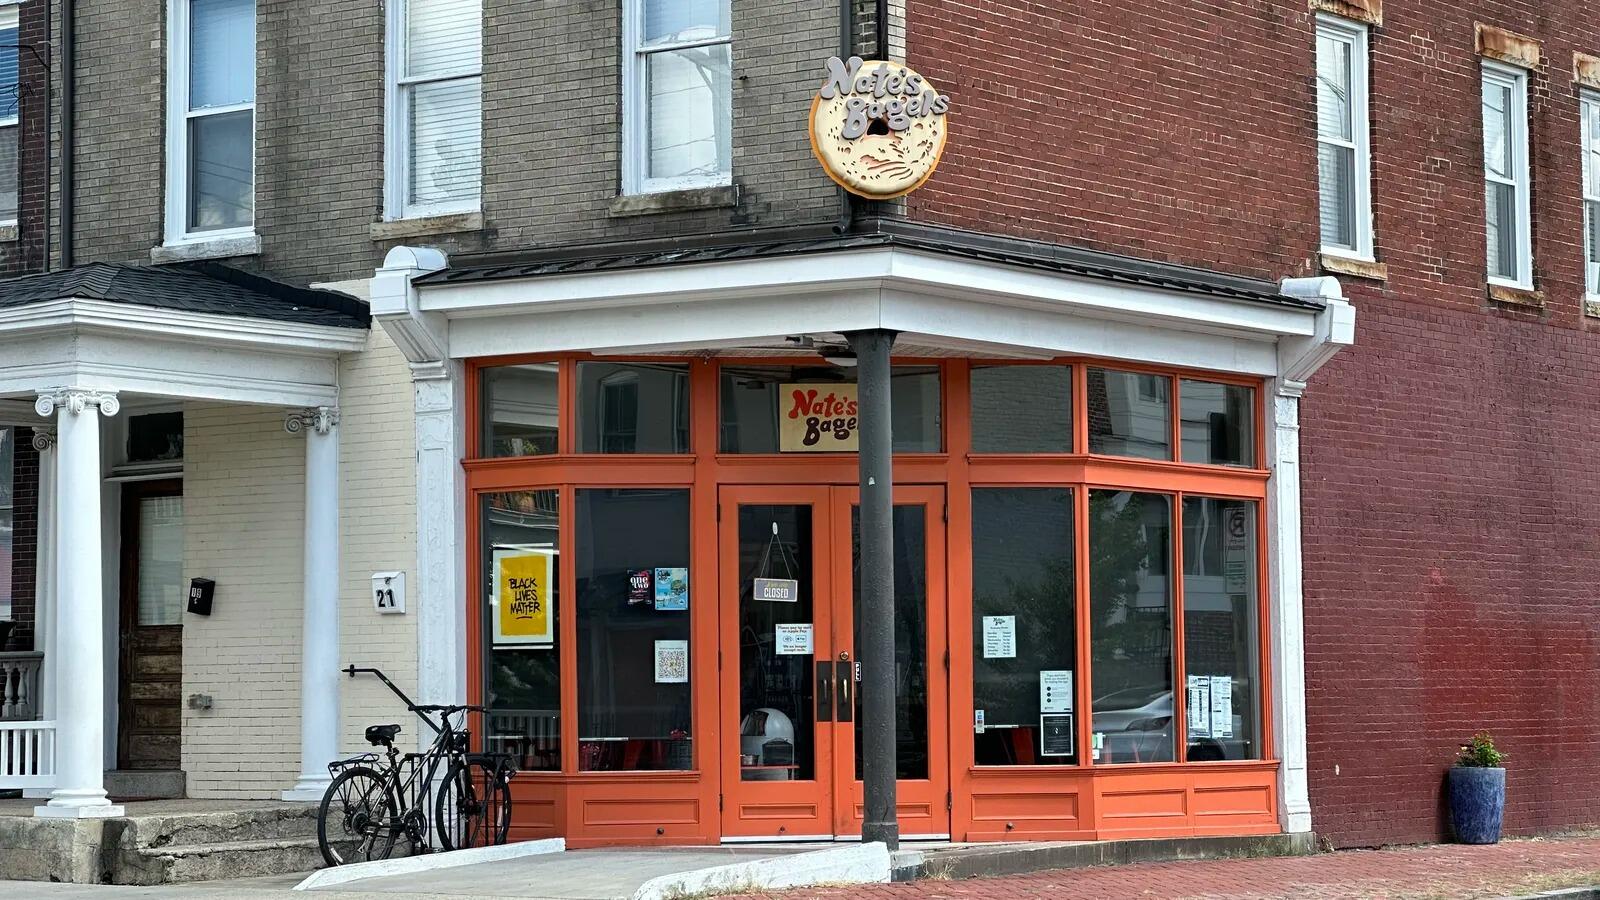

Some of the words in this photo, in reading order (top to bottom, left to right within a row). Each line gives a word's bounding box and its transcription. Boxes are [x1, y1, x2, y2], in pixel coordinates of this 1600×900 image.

[820, 56, 922, 99] Nate's
[841, 90, 950, 140] Bagels
[788, 389, 858, 419] Nate's
[803, 416, 859, 446] Bage
[508, 578, 538, 590] BLACK
[763, 587, 789, 599] CLOSED
[376, 589, 395, 608] 21
[514, 590, 538, 602] LIVES
[510, 602, 541, 615] MATTER
